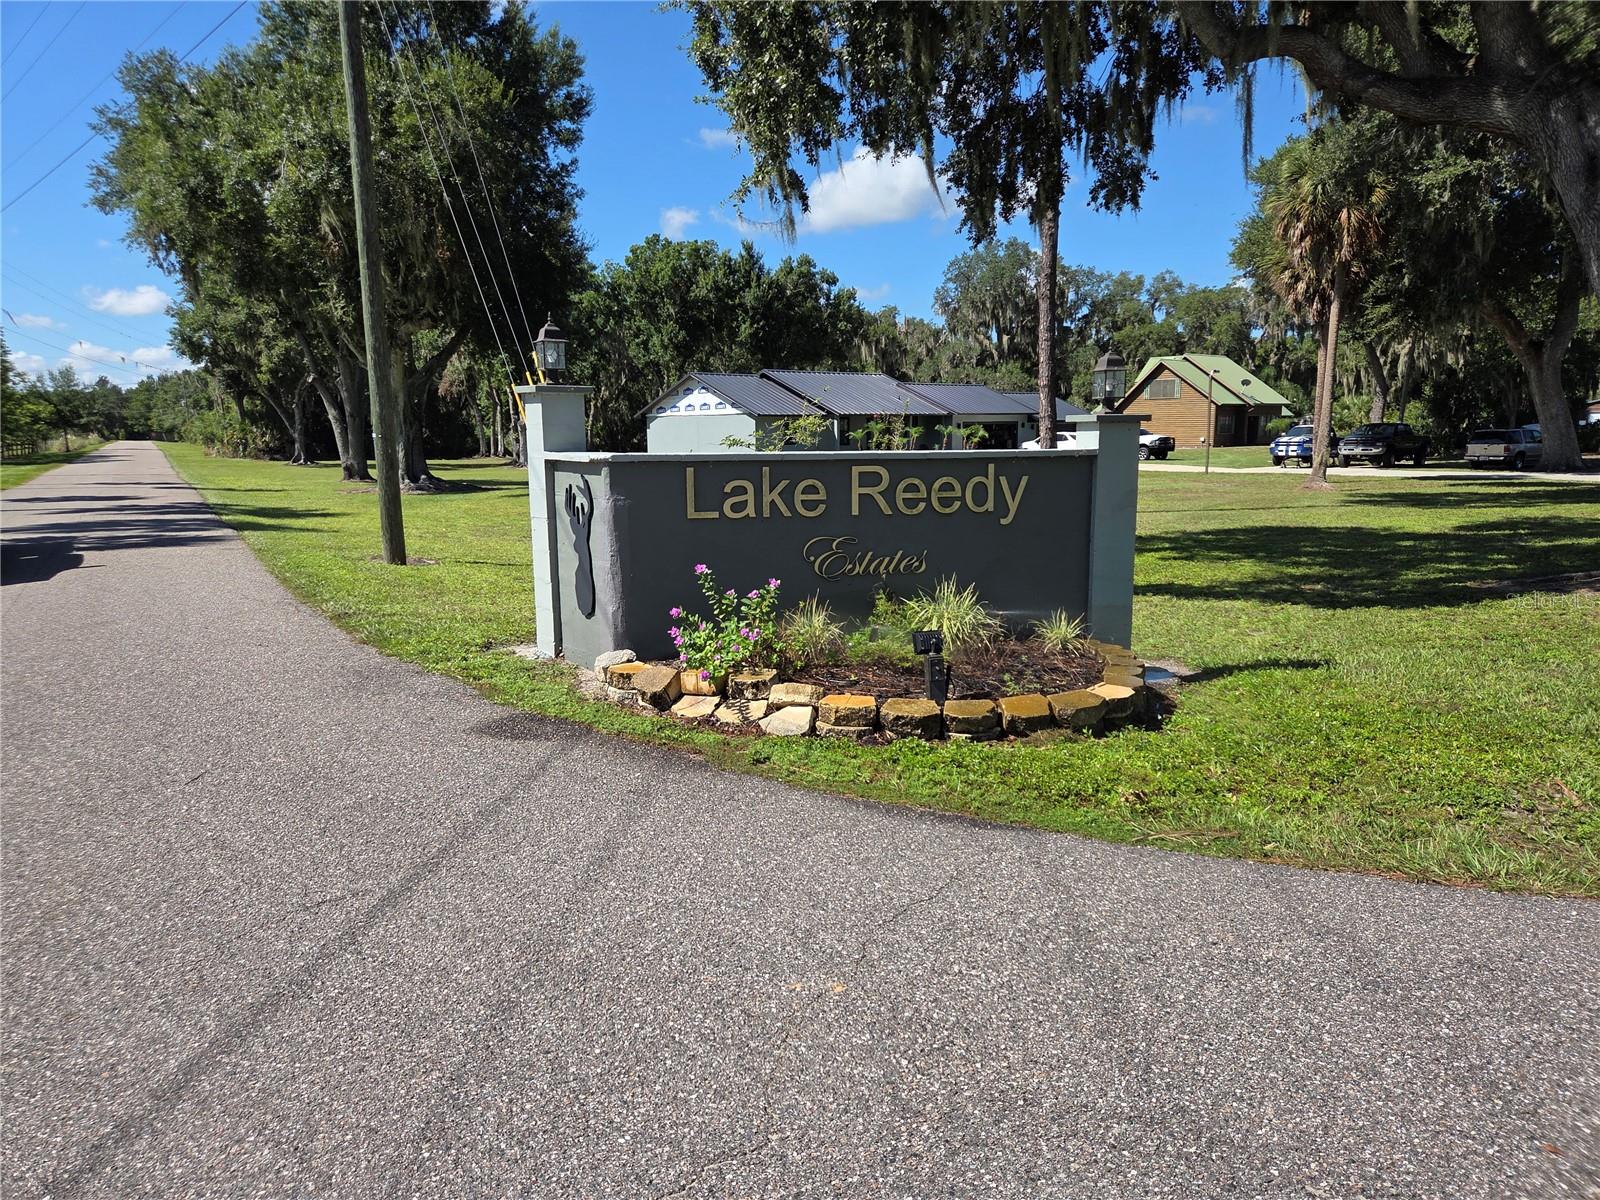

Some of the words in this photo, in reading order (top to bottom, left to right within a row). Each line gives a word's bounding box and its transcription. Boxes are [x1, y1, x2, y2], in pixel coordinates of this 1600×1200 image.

[686, 466, 827, 520] Lake
[850, 463, 1029, 525] Reedy
[803, 536, 928, 582] Estates
